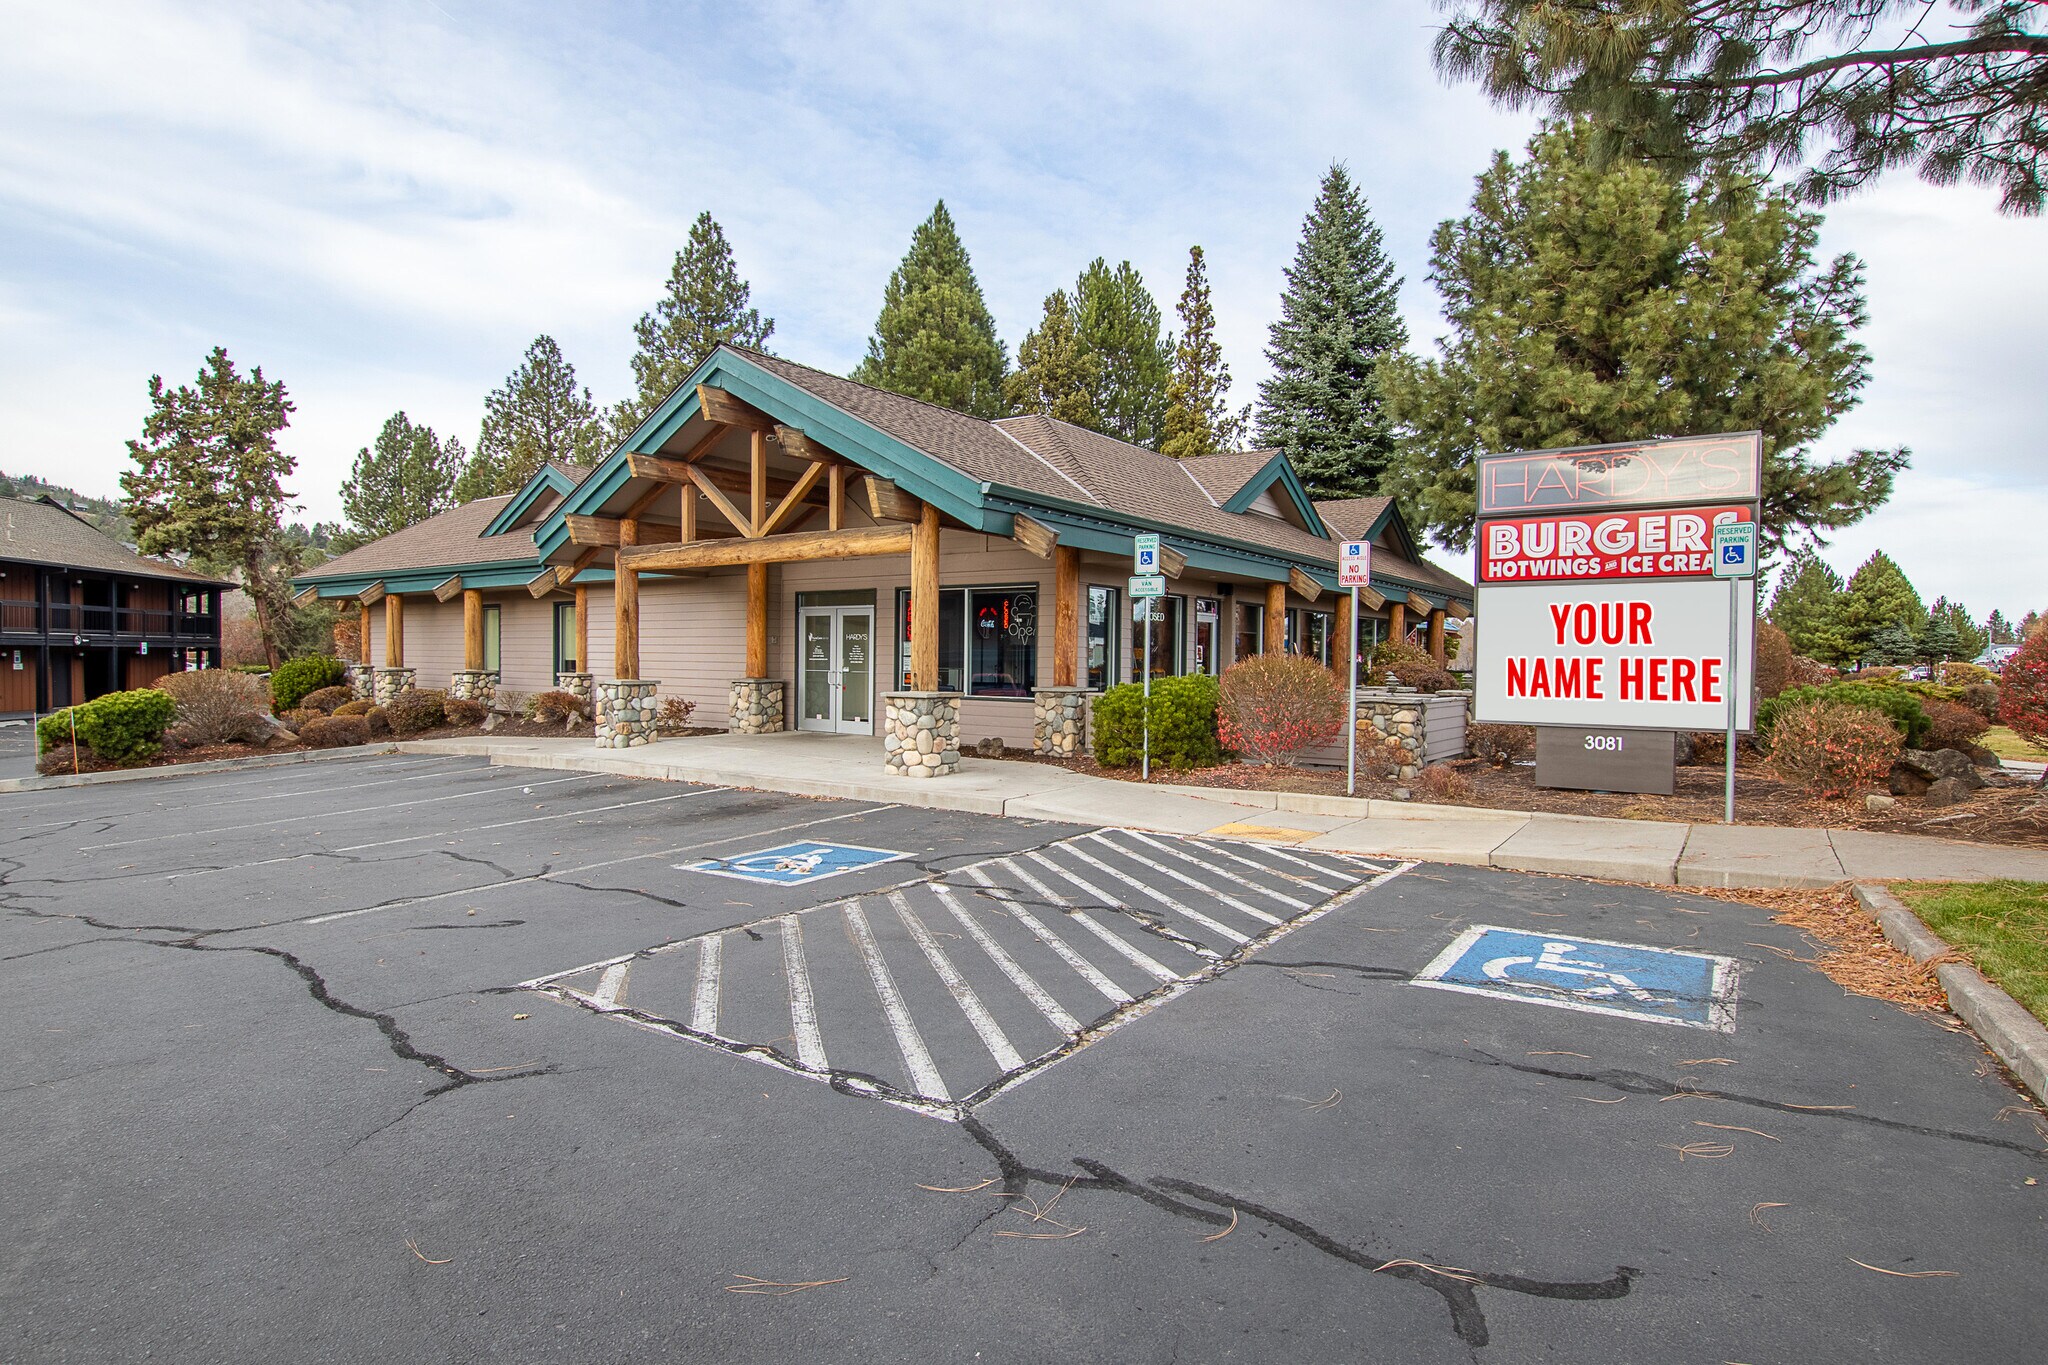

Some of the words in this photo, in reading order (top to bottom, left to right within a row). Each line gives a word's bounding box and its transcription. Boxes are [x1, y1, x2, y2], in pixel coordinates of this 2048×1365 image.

[1491, 447, 1741, 505] HARDY'S
[1717, 526, 1753, 535] RESERVED
[1720, 535, 1750, 544] PARKING
[1349, 565, 1359, 573] NO
[1488, 557, 1601, 578] HOTWINGS
[1620, 555, 1654, 574] ICE
[1658, 553, 1714, 573] CREA
[1341, 575, 1367, 583] PARKING
[1549, 602, 1654, 645] YOUR
[1506, 657, 1605, 700] NAME
[1619, 658, 1723, 703] HERE
[1584, 736, 1623, 751] 3081
